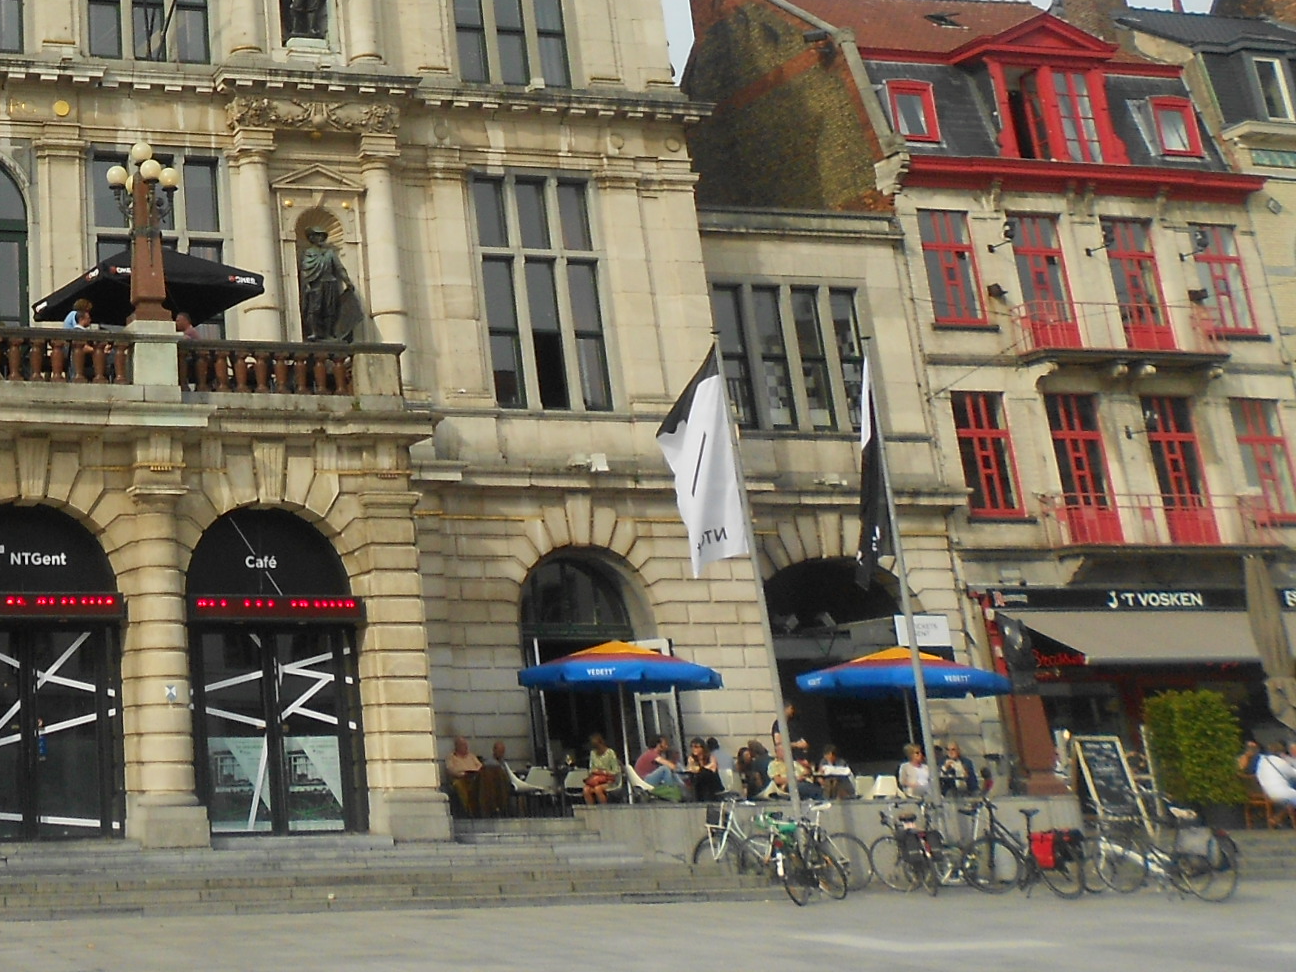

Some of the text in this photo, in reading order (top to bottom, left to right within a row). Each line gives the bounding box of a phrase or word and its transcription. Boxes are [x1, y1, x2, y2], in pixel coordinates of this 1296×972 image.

[10, 552, 67, 566] NTGent
[245, 555, 278, 569] Café
[1136, 592, 1203, 607] VOSKEN
